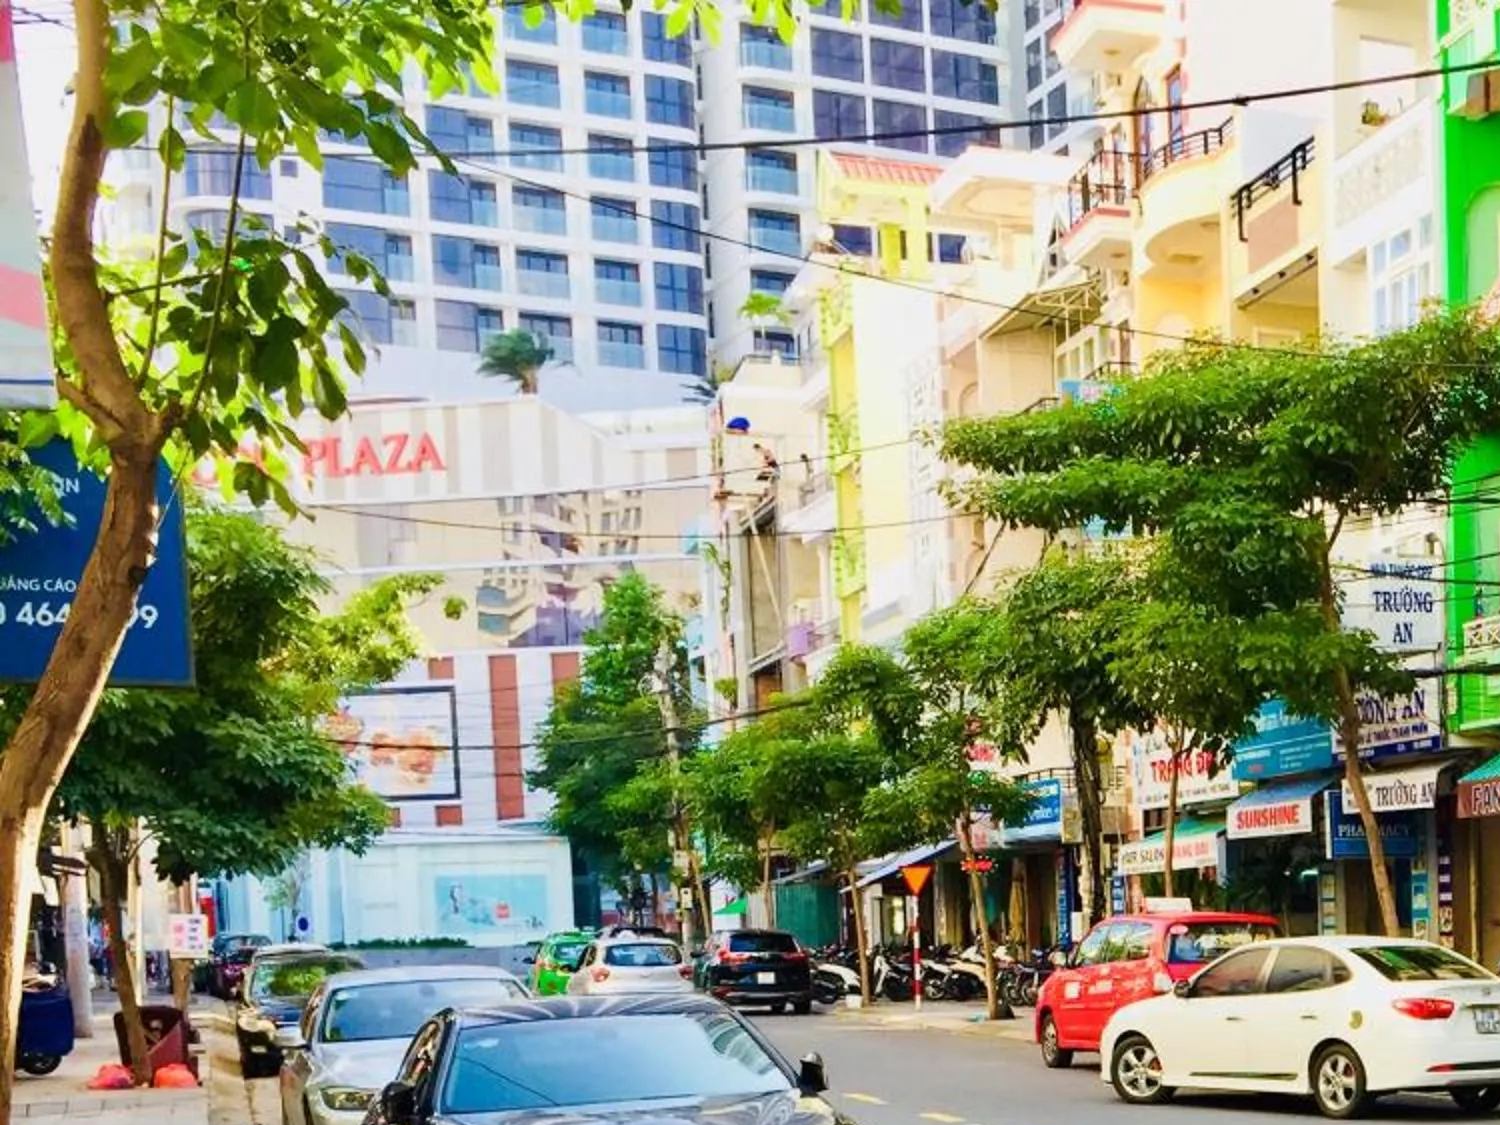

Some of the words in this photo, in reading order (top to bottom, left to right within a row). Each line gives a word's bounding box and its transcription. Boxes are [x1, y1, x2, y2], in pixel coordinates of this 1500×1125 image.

[302, 433, 447, 478] PLAZA
[1393, 622, 1413, 643] AN
[1236, 803, 1301, 830] SUNSHINE
